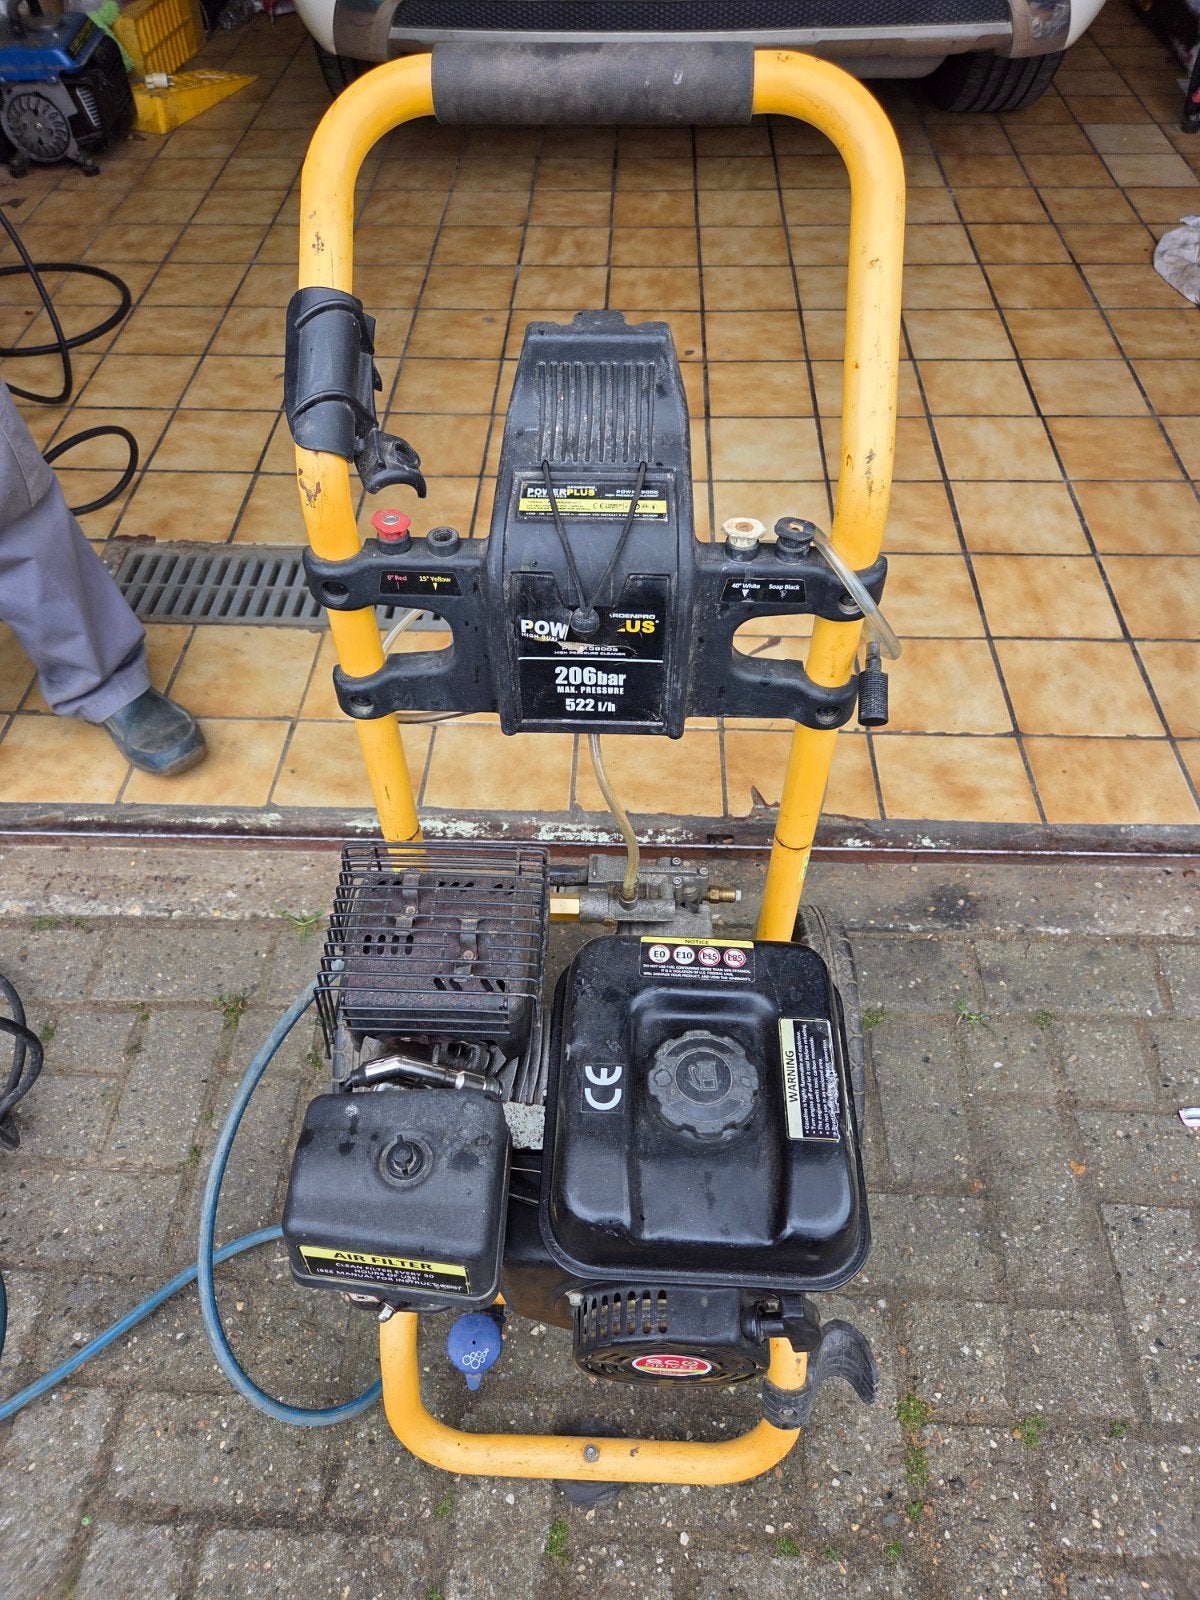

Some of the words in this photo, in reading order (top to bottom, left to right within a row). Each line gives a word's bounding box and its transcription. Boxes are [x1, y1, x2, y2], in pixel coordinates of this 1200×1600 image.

[554, 666, 626, 686] 206bar
[557, 686, 578, 694] MAX.
[580, 686, 624, 695] PRESSURE
[566, 698, 594, 712] 522
[654, 950, 666, 958] E0
[702, 952, 717, 960] E15
[785, 1050, 798, 1102] WARNING
[824, 1122, 829, 1130] Do
[333, 1252, 365, 1261] AIR
[371, 1256, 432, 1270] FILTER
[336, 1270, 374, 1279] MANUAL
[354, 1268, 384, 1276] HOURS
